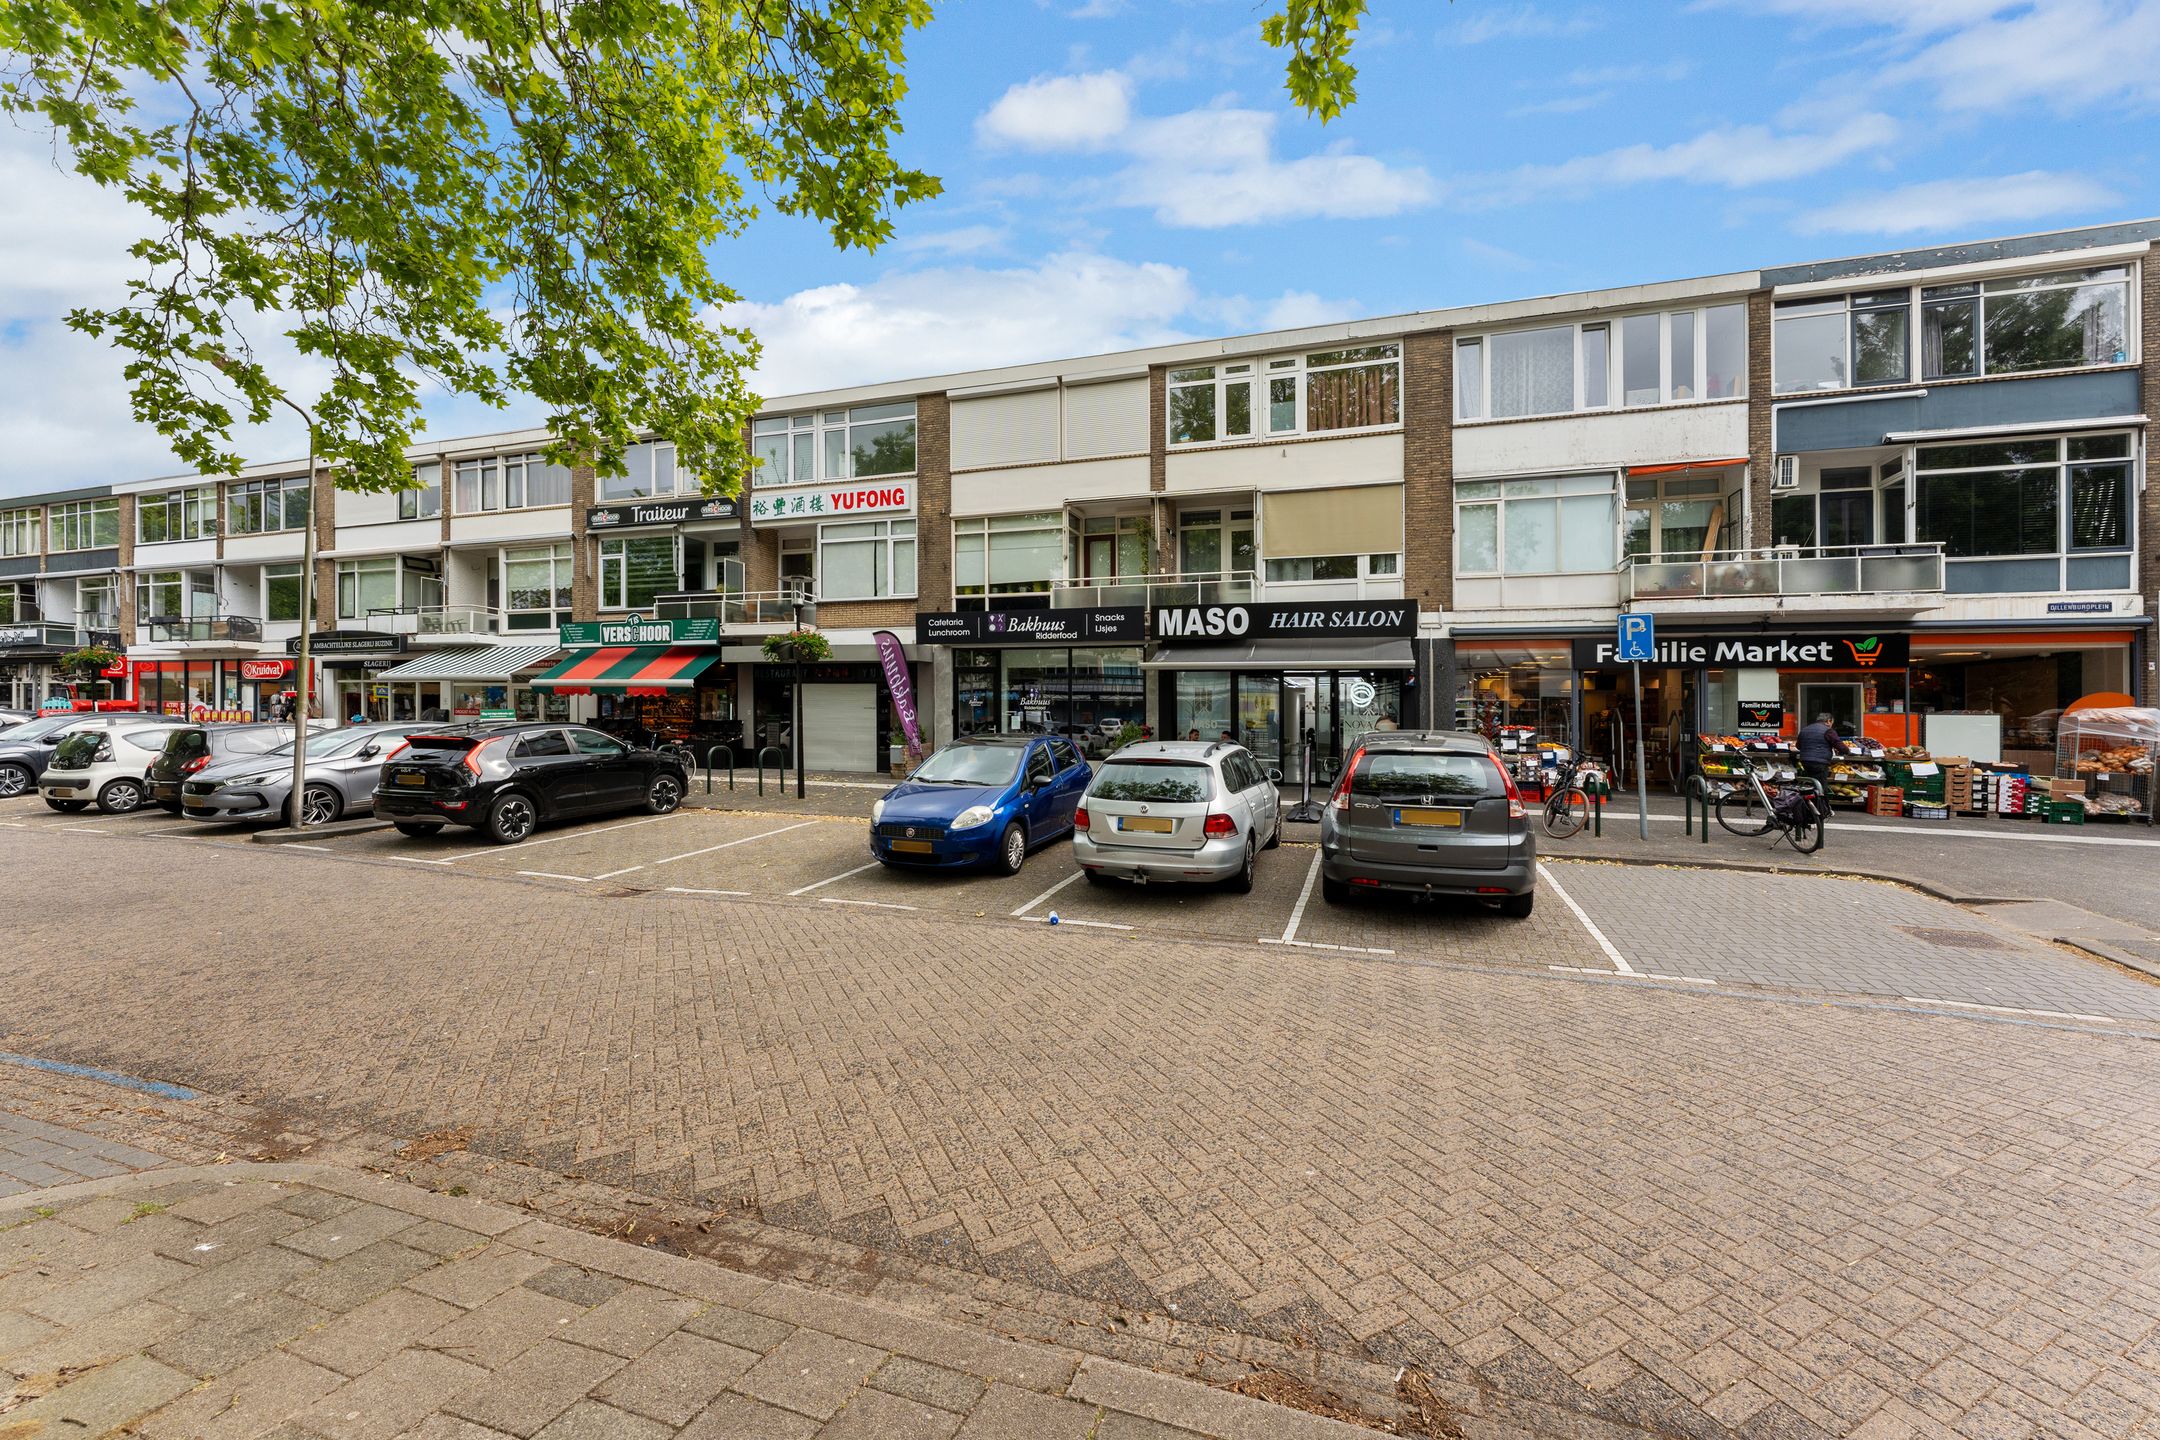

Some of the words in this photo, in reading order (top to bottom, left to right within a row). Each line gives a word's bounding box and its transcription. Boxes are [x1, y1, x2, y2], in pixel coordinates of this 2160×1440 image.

[831, 487, 905, 511] YUFONG
[631, 506, 689, 523] Traiteur
[928, 618, 964, 627] Cafetaria
[1007, 616, 1066, 633] Bakhuus
[1095, 613, 1125, 622] Snacks
[1158, 606, 1250, 637] MASO
[1269, 610, 1325, 629] HAIR
[1329, 609, 1405, 628] SALON
[603, 624, 671, 643] VERSCHOOR
[928, 628, 971, 637] Lunchroom
[1035, 631, 1078, 640] Ridderfood
[1095, 624, 1117, 634] IJsjes
[1626, 618, 1646, 640] P
[1714, 639, 1833, 663] Market
[252, 664, 281, 675] Kruidvat
[363, 660, 391, 668] SLAGERIJ
[1020, 697, 1051, 706] Bakhuus
